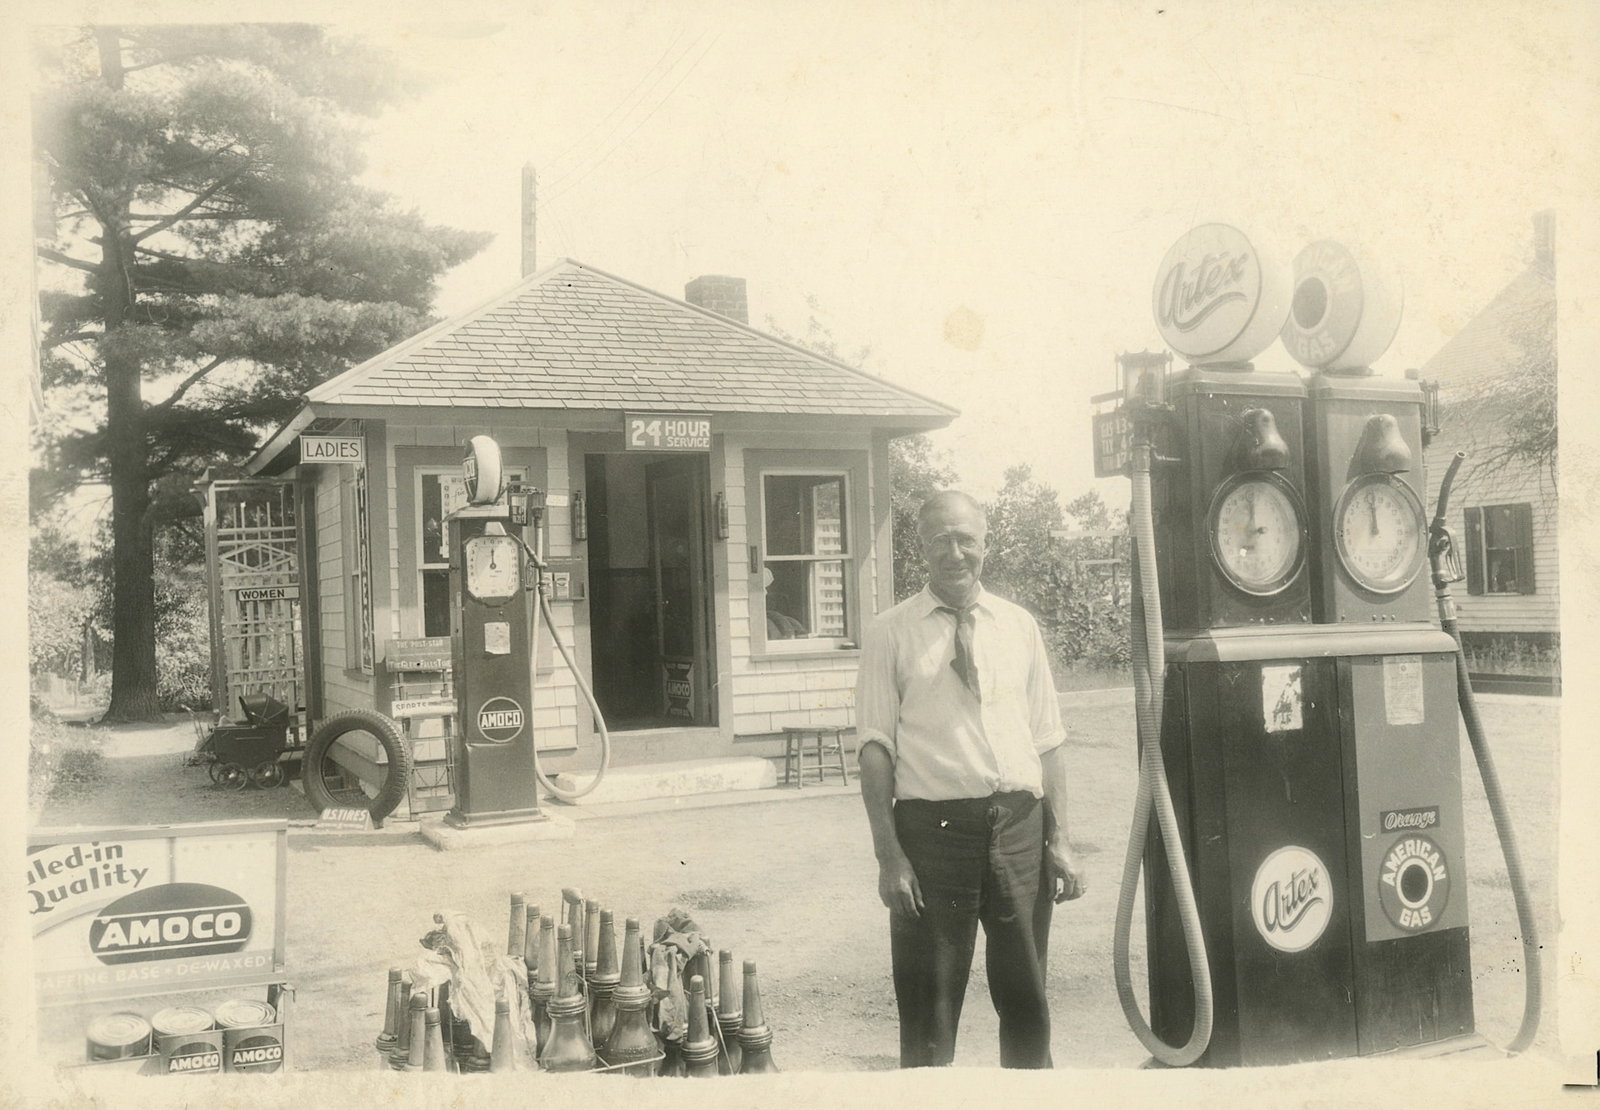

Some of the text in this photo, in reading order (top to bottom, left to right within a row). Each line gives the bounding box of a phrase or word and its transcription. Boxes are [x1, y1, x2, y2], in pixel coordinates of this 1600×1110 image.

[1159, 251, 1249, 333] Artex
[631, 420, 711, 447] 24 HOUR
[667, 437, 710, 448] SERVICE
[305, 441, 360, 458] LADIES
[241, 588, 285, 600] WOMEN
[481, 711, 521, 728] AMOCO
[338, 808, 368, 821] TIRES
[1384, 810, 1436, 830] Orange
[1382, 839, 1447, 888] AMERICAN
[27, 863, 149, 915] Quality
[1263, 867, 1323, 933] Artex
[1399, 906, 1433, 928] GAS
[98, 911, 242, 949] AMOCO
[116, 966, 160, 982] BASE
[177, 955, 266, 976] DE-WAXED
[169, 1053, 219, 1072] AMOCO
[233, 1046, 282, 1063] AMOCO
